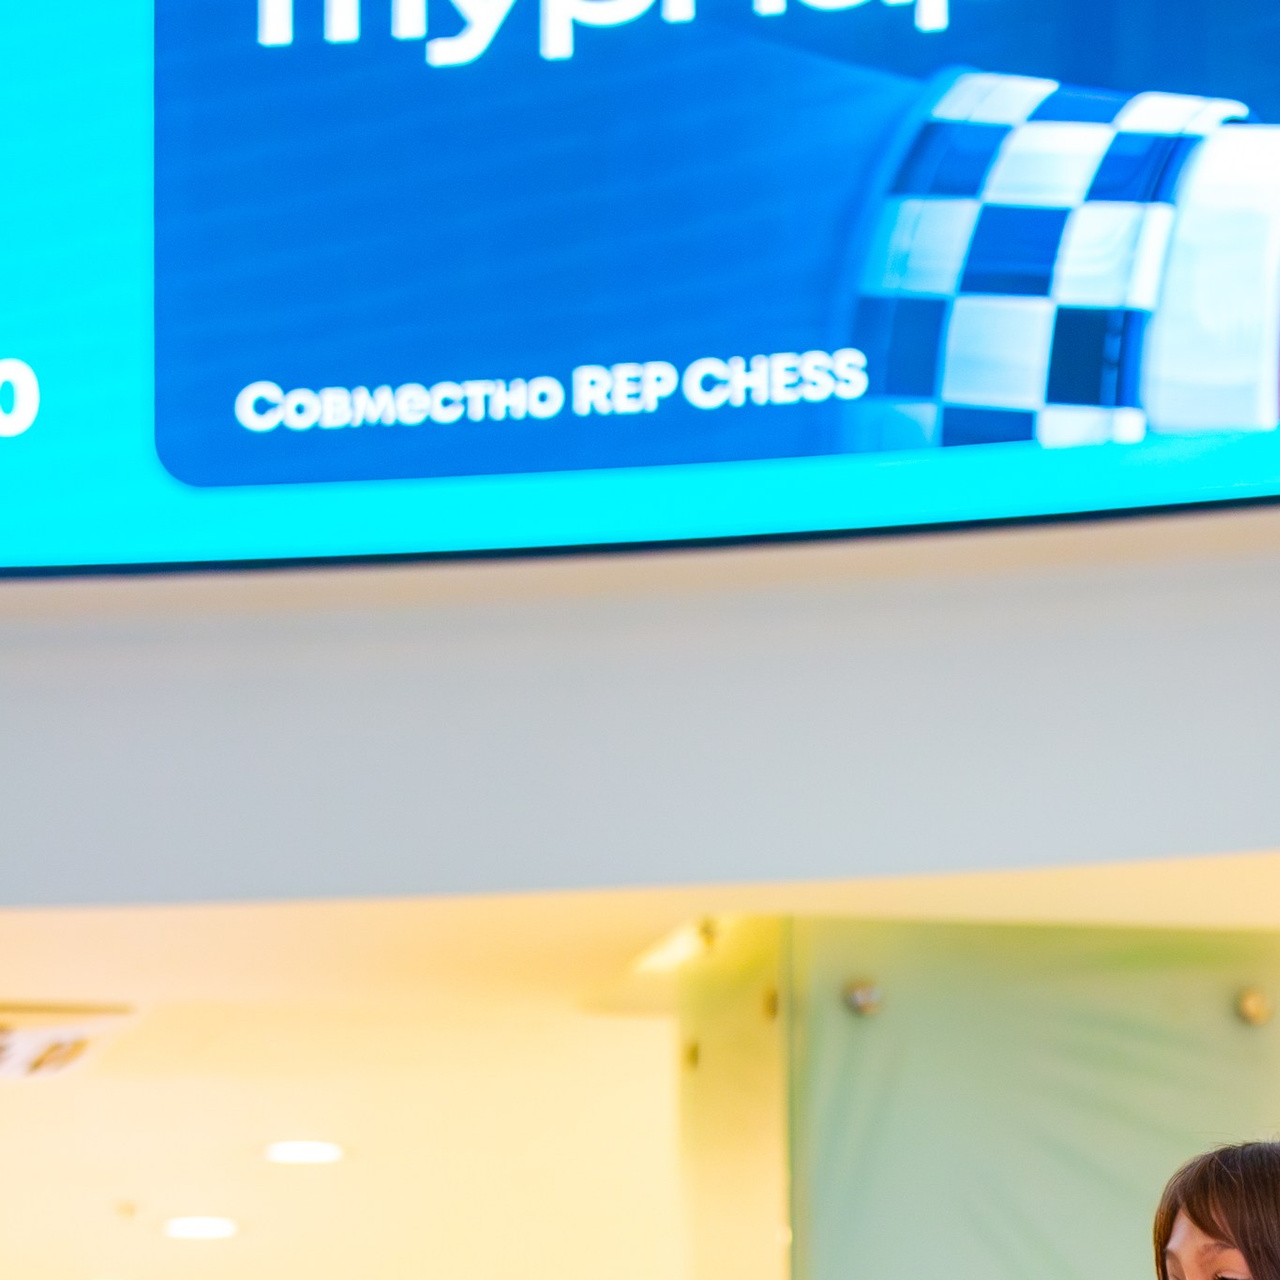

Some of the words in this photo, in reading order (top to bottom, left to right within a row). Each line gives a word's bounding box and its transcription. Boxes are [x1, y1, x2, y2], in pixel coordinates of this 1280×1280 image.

[235, 377, 565, 432] Совместно
[573, 361, 678, 416] REP
[682, 348, 869, 410] CHESS
